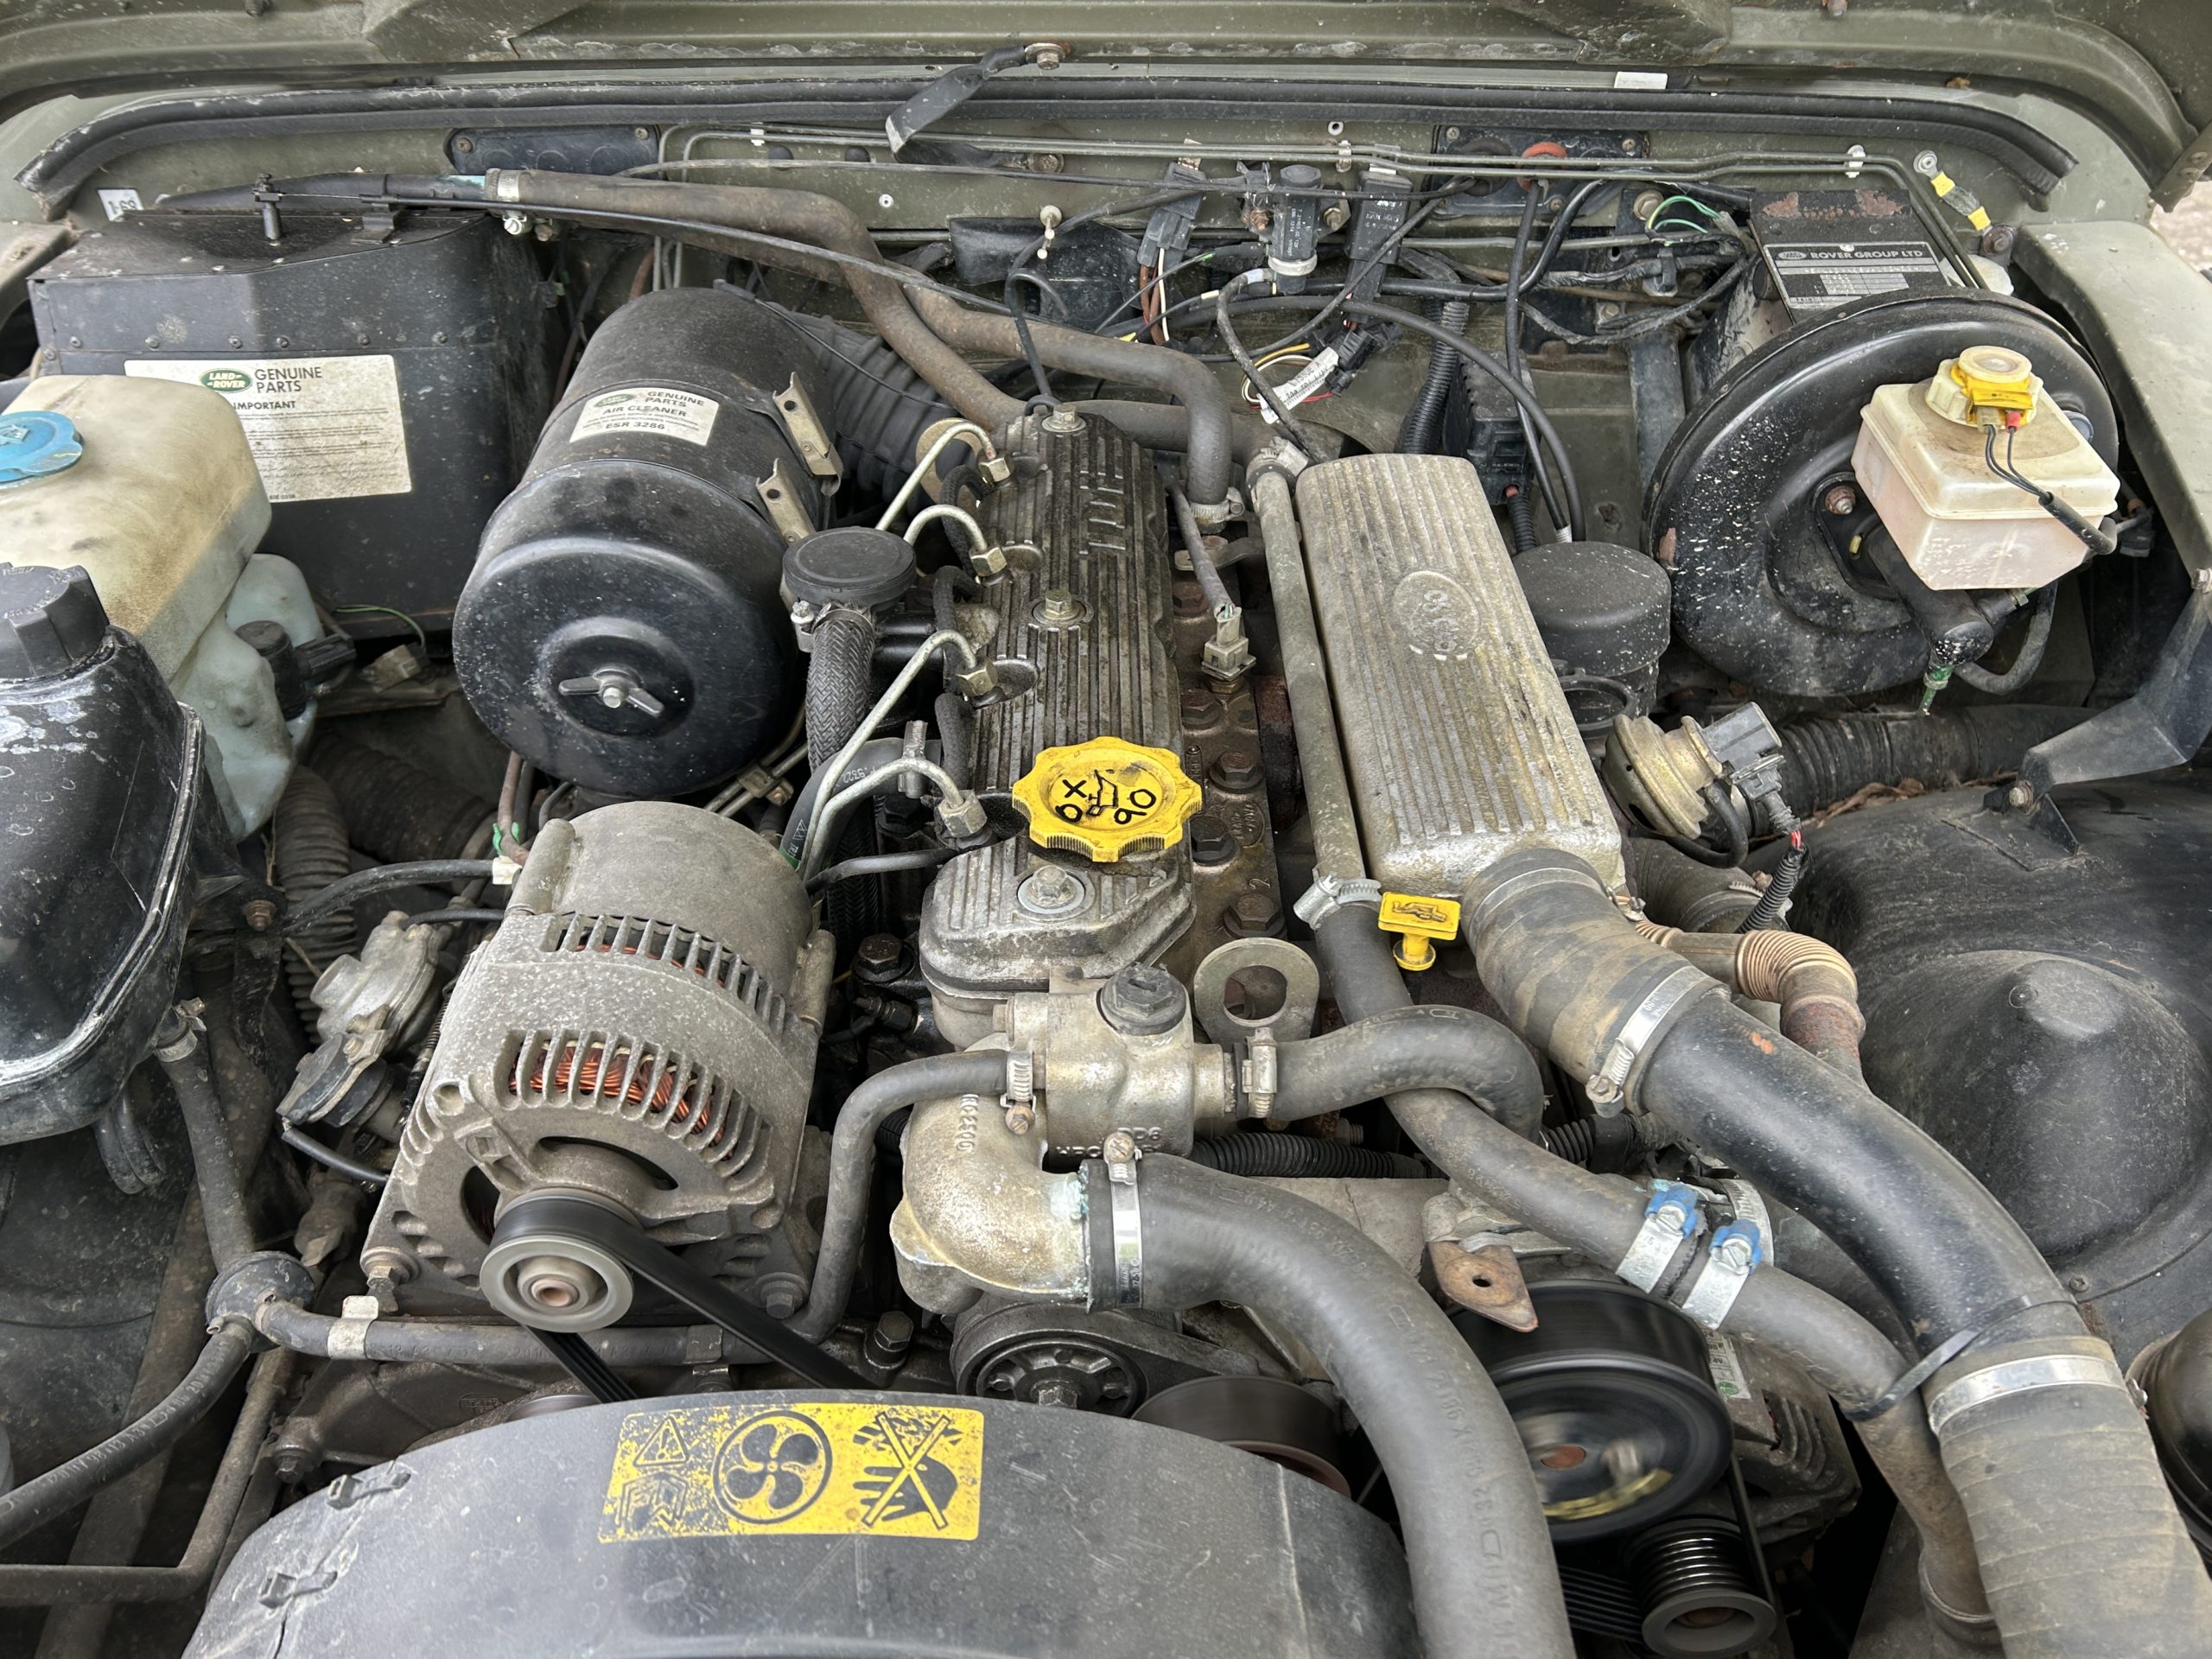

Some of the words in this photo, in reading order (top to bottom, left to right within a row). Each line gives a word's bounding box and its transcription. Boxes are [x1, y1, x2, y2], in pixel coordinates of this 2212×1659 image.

[1810, 251, 1853, 260] ROVER
[1854, 251, 1899, 259] GROUP
[208, 372, 236, 381] LAND
[254, 366, 322, 381] GENUINE
[212, 380, 246, 390] ROVER
[257, 380, 302, 394] PARTS
[645, 397, 688, 409] PARTS
[647, 391, 705, 407] GENUINE
[233, 400, 296, 410] IMPORTANT
[602, 405, 625, 415] AIR
[627, 405, 688, 417] CLEANER
[633, 422, 665, 430] 3286
